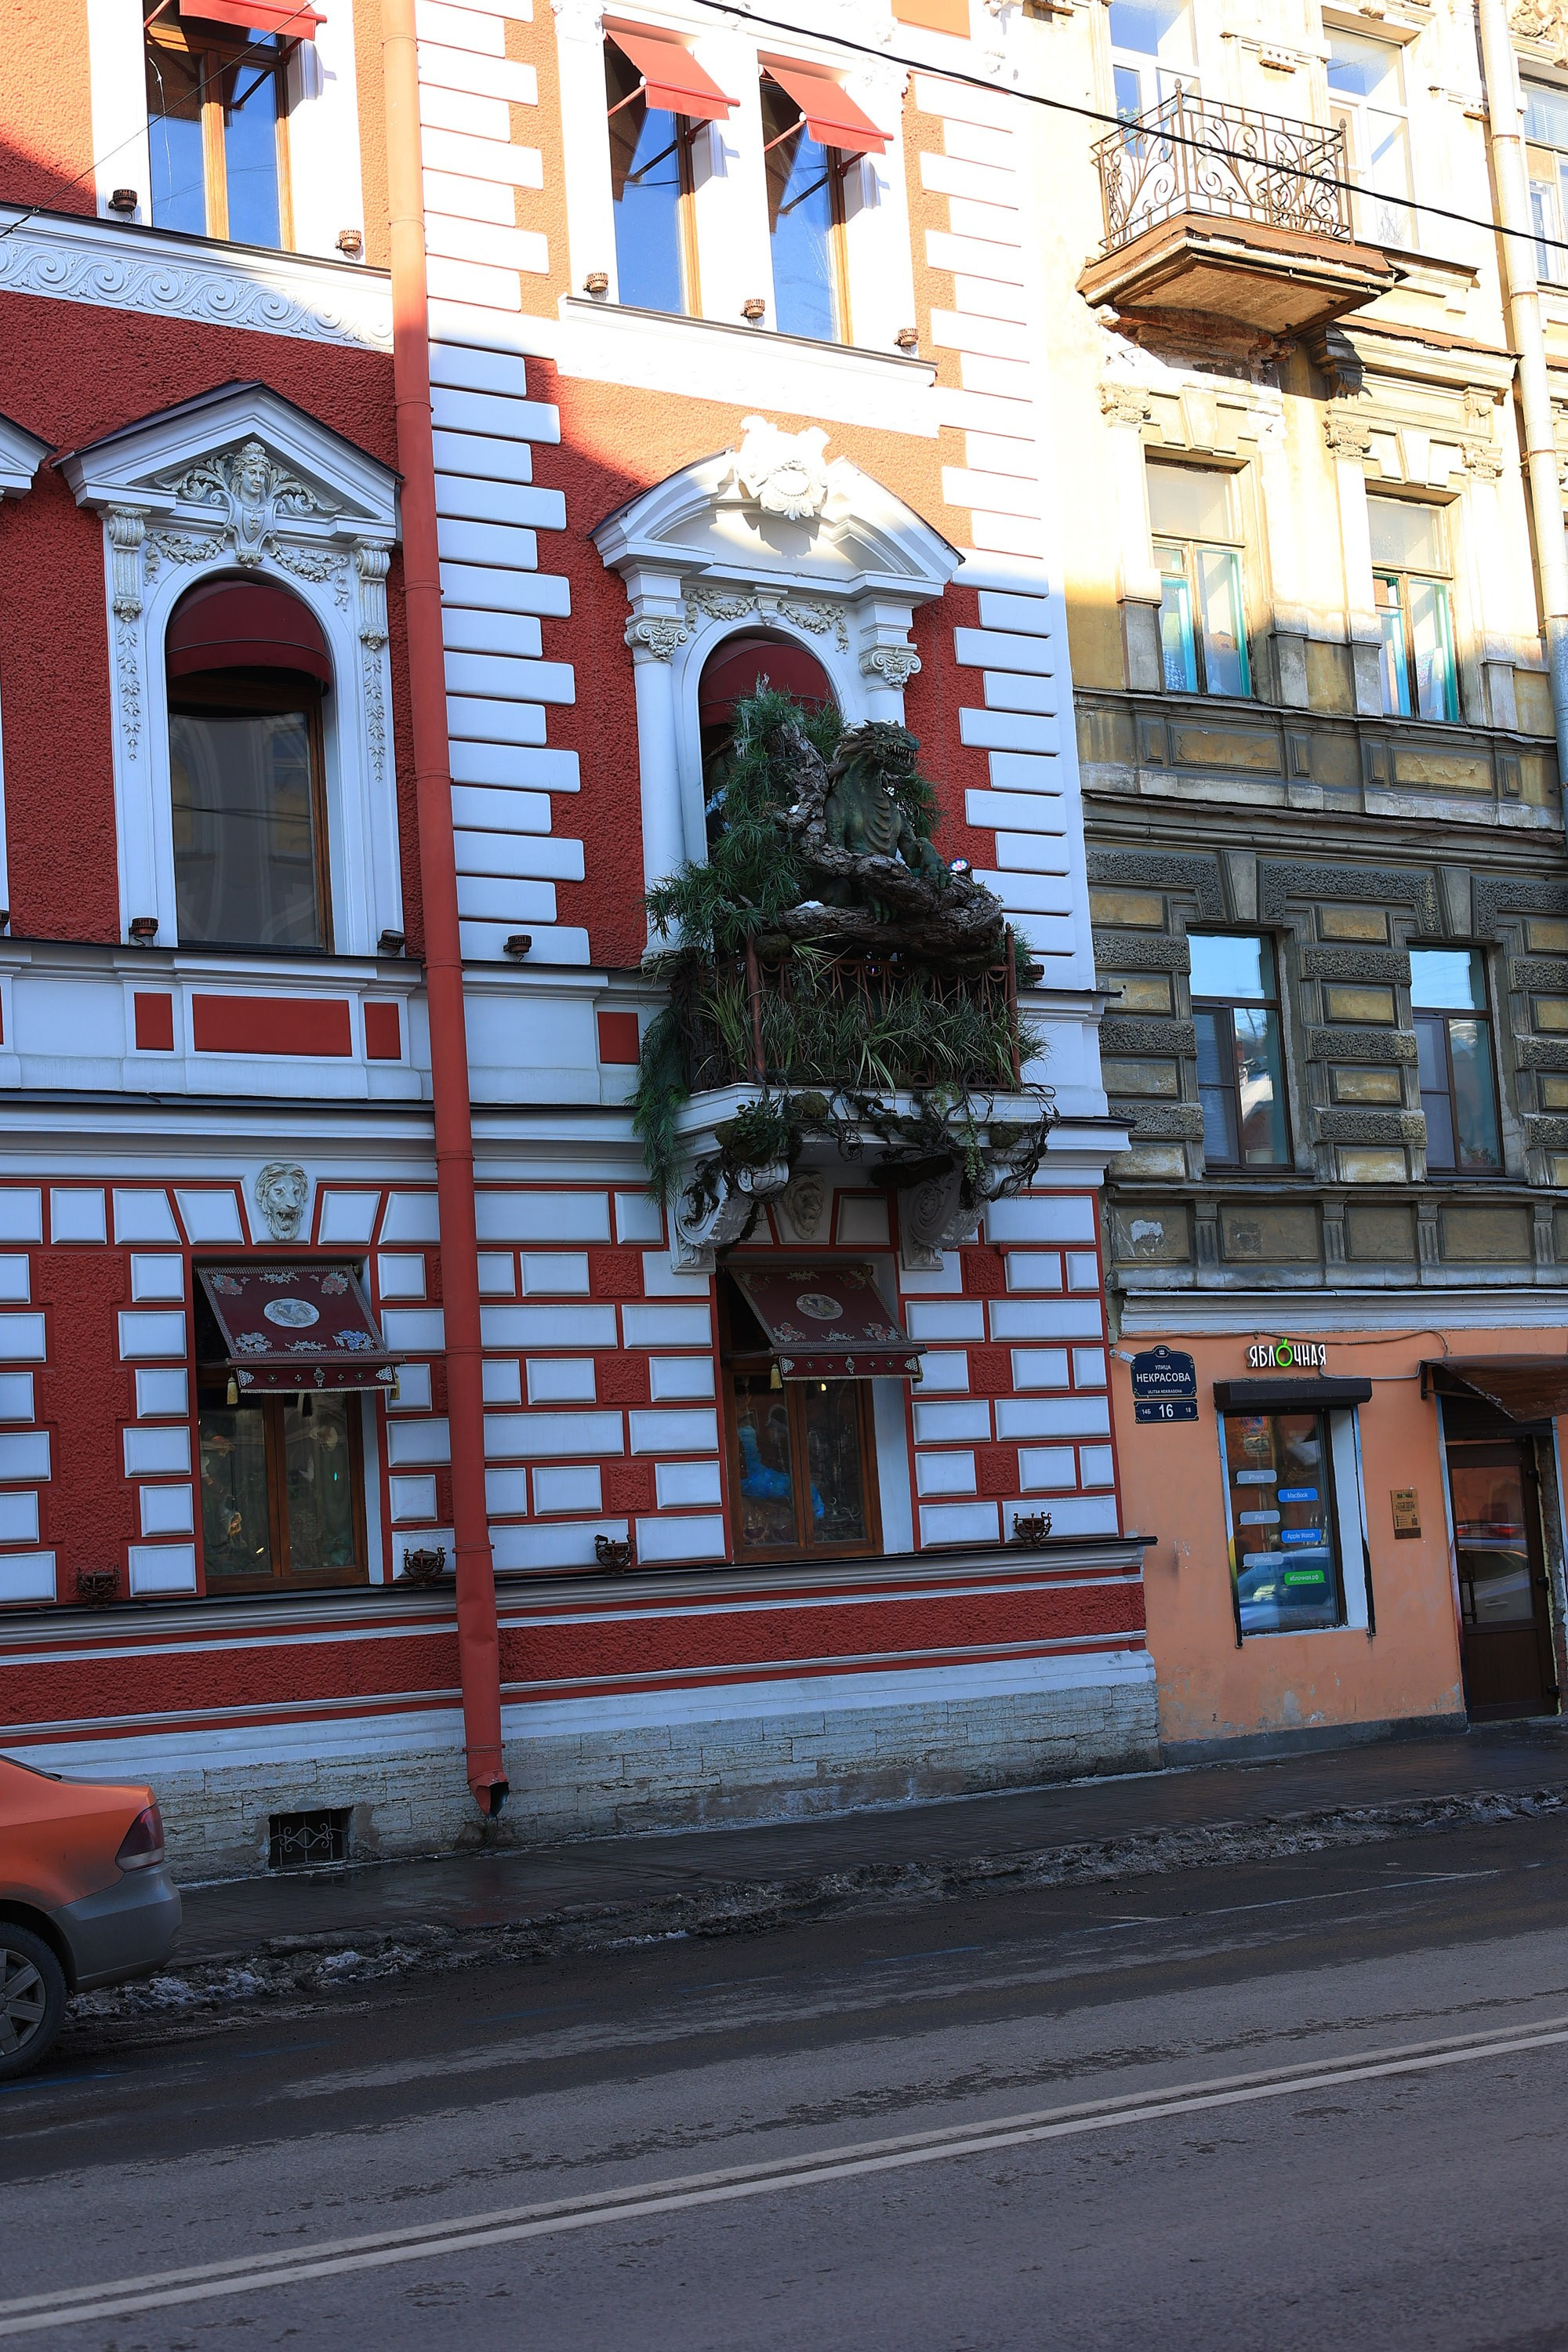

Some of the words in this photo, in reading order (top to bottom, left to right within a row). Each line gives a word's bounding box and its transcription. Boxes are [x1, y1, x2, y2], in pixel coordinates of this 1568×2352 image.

[1249, 1341, 1327, 1367] ЯБЛОЧНАЯ
[1136, 1372, 1191, 1383] НЕКРАСОВА
[1159, 1403, 1174, 1417] 16
